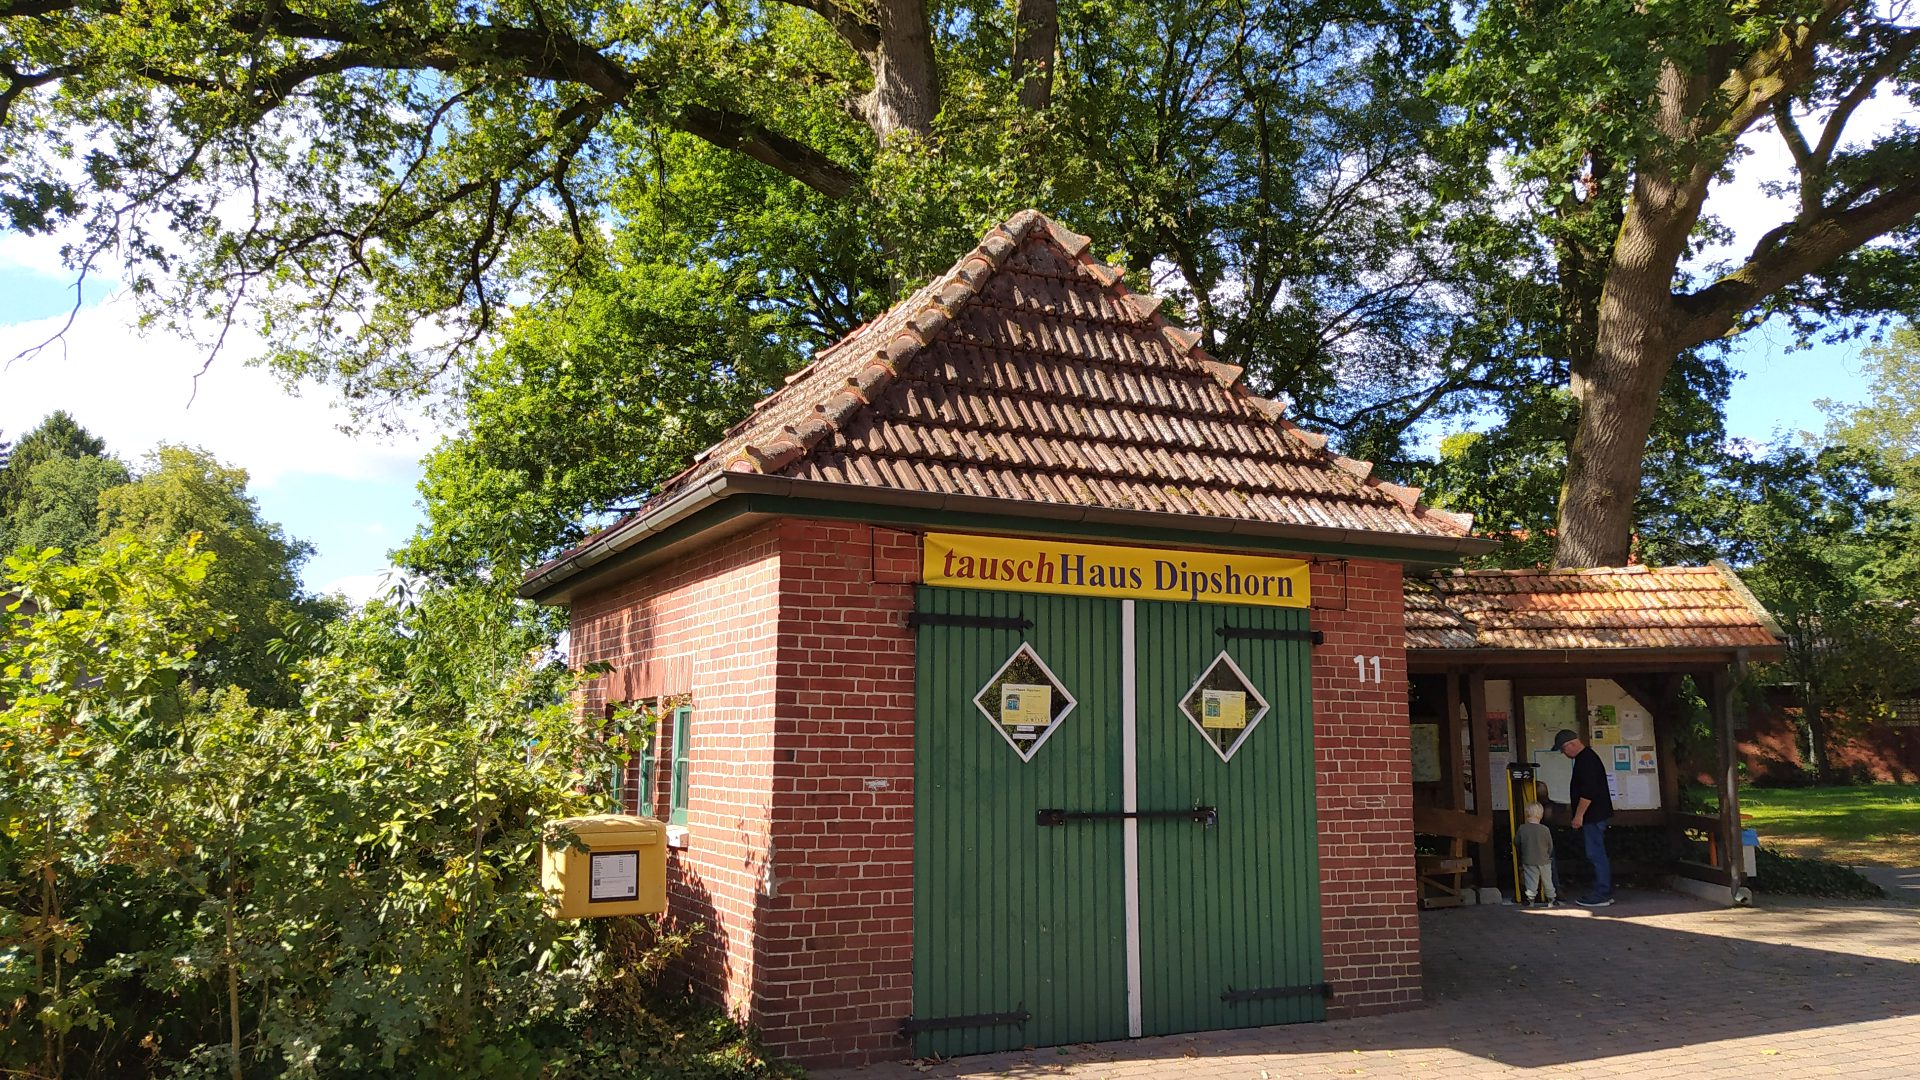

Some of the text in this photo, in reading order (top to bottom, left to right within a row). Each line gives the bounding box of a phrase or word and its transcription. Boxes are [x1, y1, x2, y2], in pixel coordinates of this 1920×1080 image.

[943, 548, 1294, 601] tauschHaus Dipshorn
[1353, 655, 1381, 684] 11
